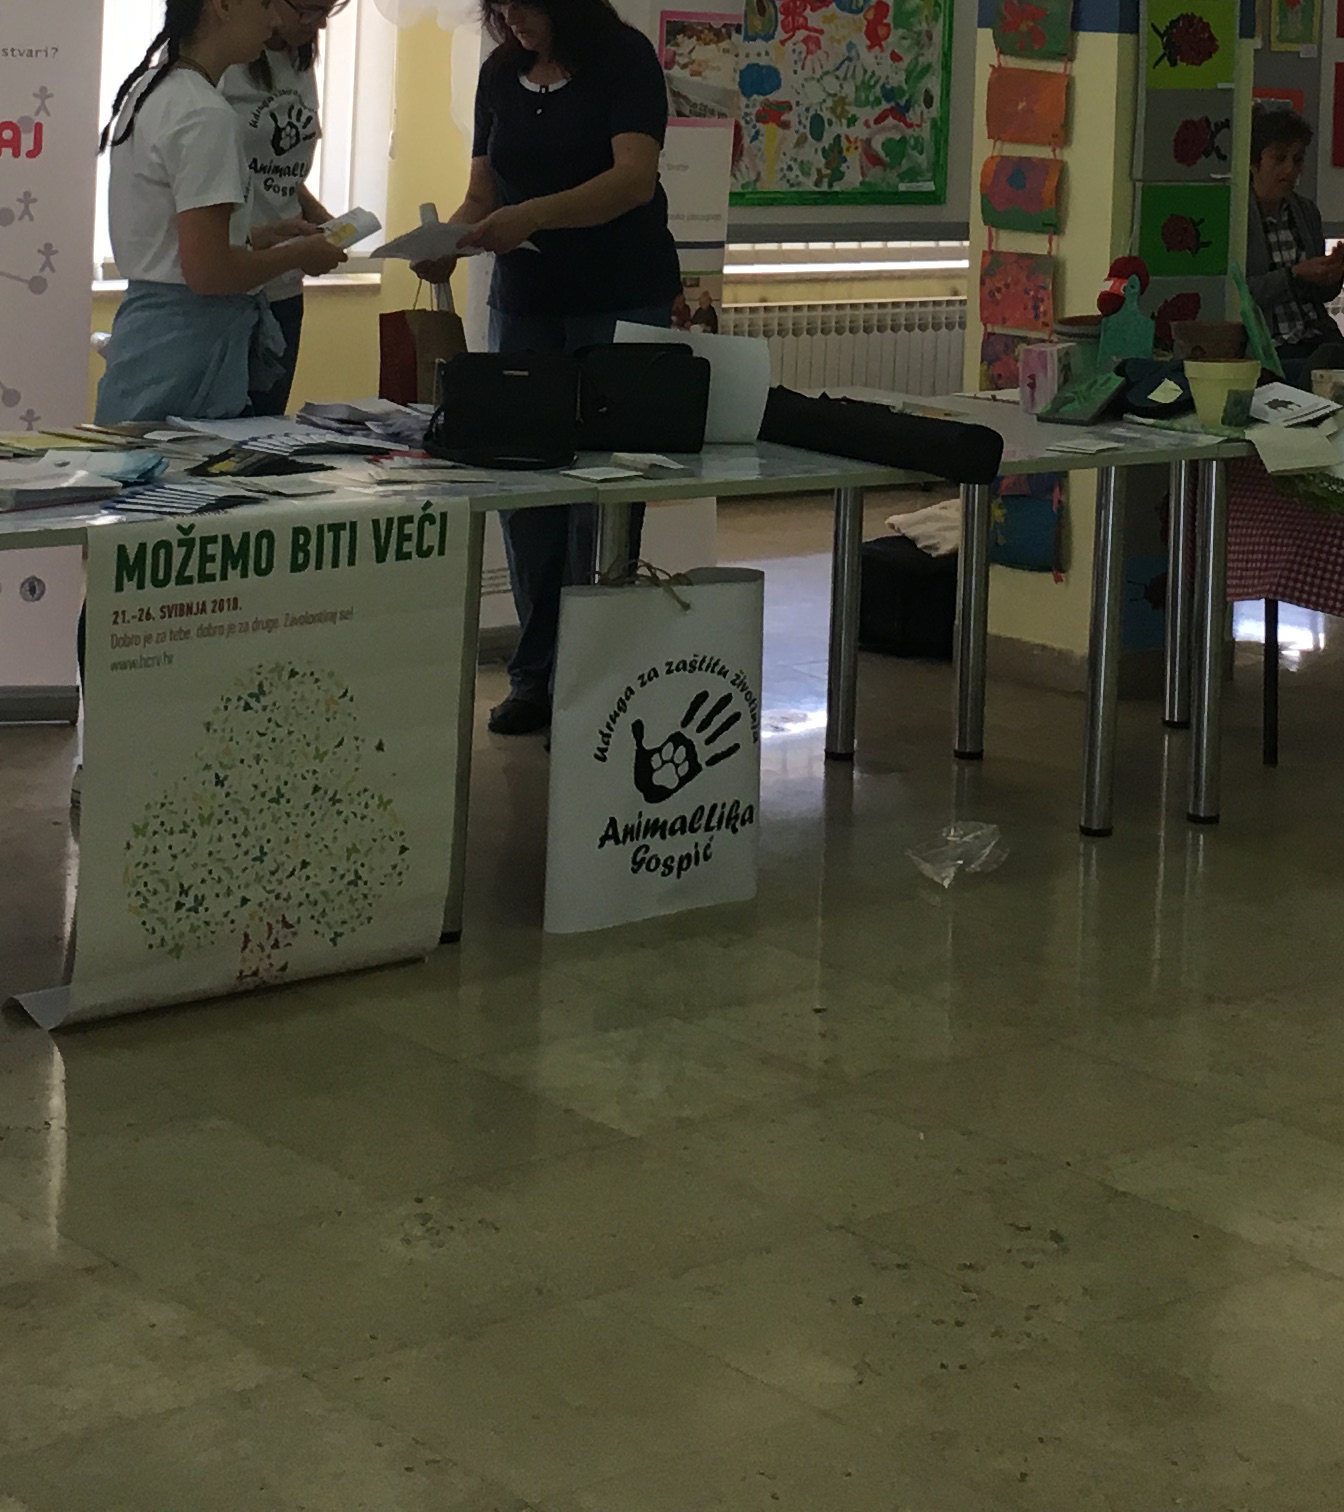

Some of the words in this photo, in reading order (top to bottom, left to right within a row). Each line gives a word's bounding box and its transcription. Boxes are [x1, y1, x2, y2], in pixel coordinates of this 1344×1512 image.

[1, 46, 59, 59] stvari?
[115, 522, 276, 593] MOŽEMO
[289, 520, 358, 574] BITI
[371, 499, 448, 565] VEĆI
[112, 607, 155, 626] 21.-26.
[159, 600, 207, 620] SVIBNJA
[211, 596, 243, 614] 2018.
[111, 633, 141, 649] Dobro
[593, 685, 636, 763] Udruga
[637, 666, 660, 688] za
[665, 653, 731, 680] zaštitu
[631, 835, 714, 879] Gospić
